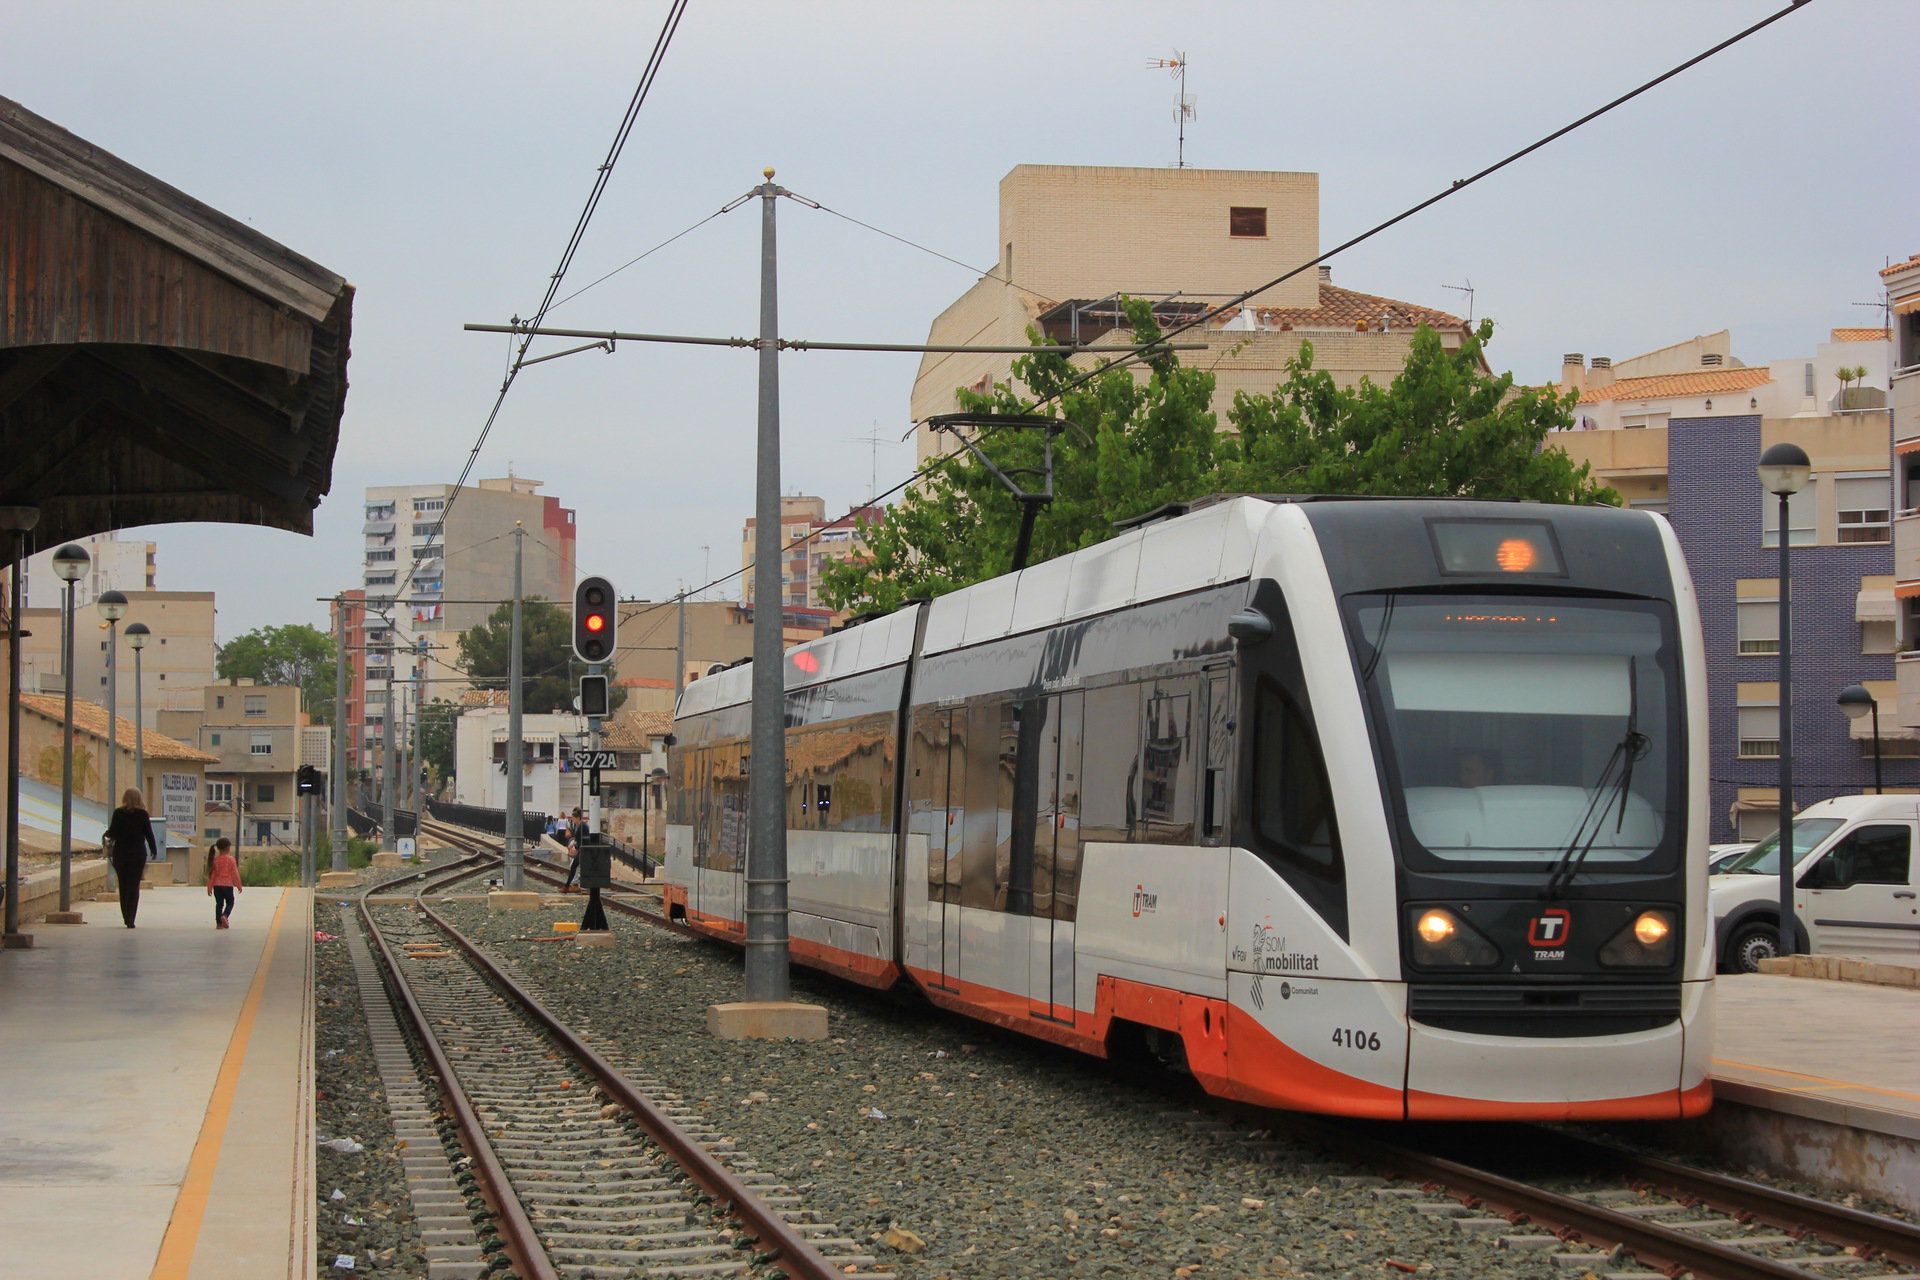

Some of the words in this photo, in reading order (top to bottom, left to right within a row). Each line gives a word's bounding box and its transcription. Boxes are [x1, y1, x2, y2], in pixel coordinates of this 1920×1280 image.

[574, 752, 617, 769] S2/2A
[163, 774, 181, 790] TALLERES
[1142, 893, 1158, 908] TRAM
[1540, 918, 1563, 939] T
[1266, 937, 1286, 952] SOM
[1265, 953, 1319, 970] mobilitat
[1534, 950, 1565, 958] TRAM
[1291, 986, 1319, 995] Comunitat
[1332, 1027, 1381, 1051] 4106
